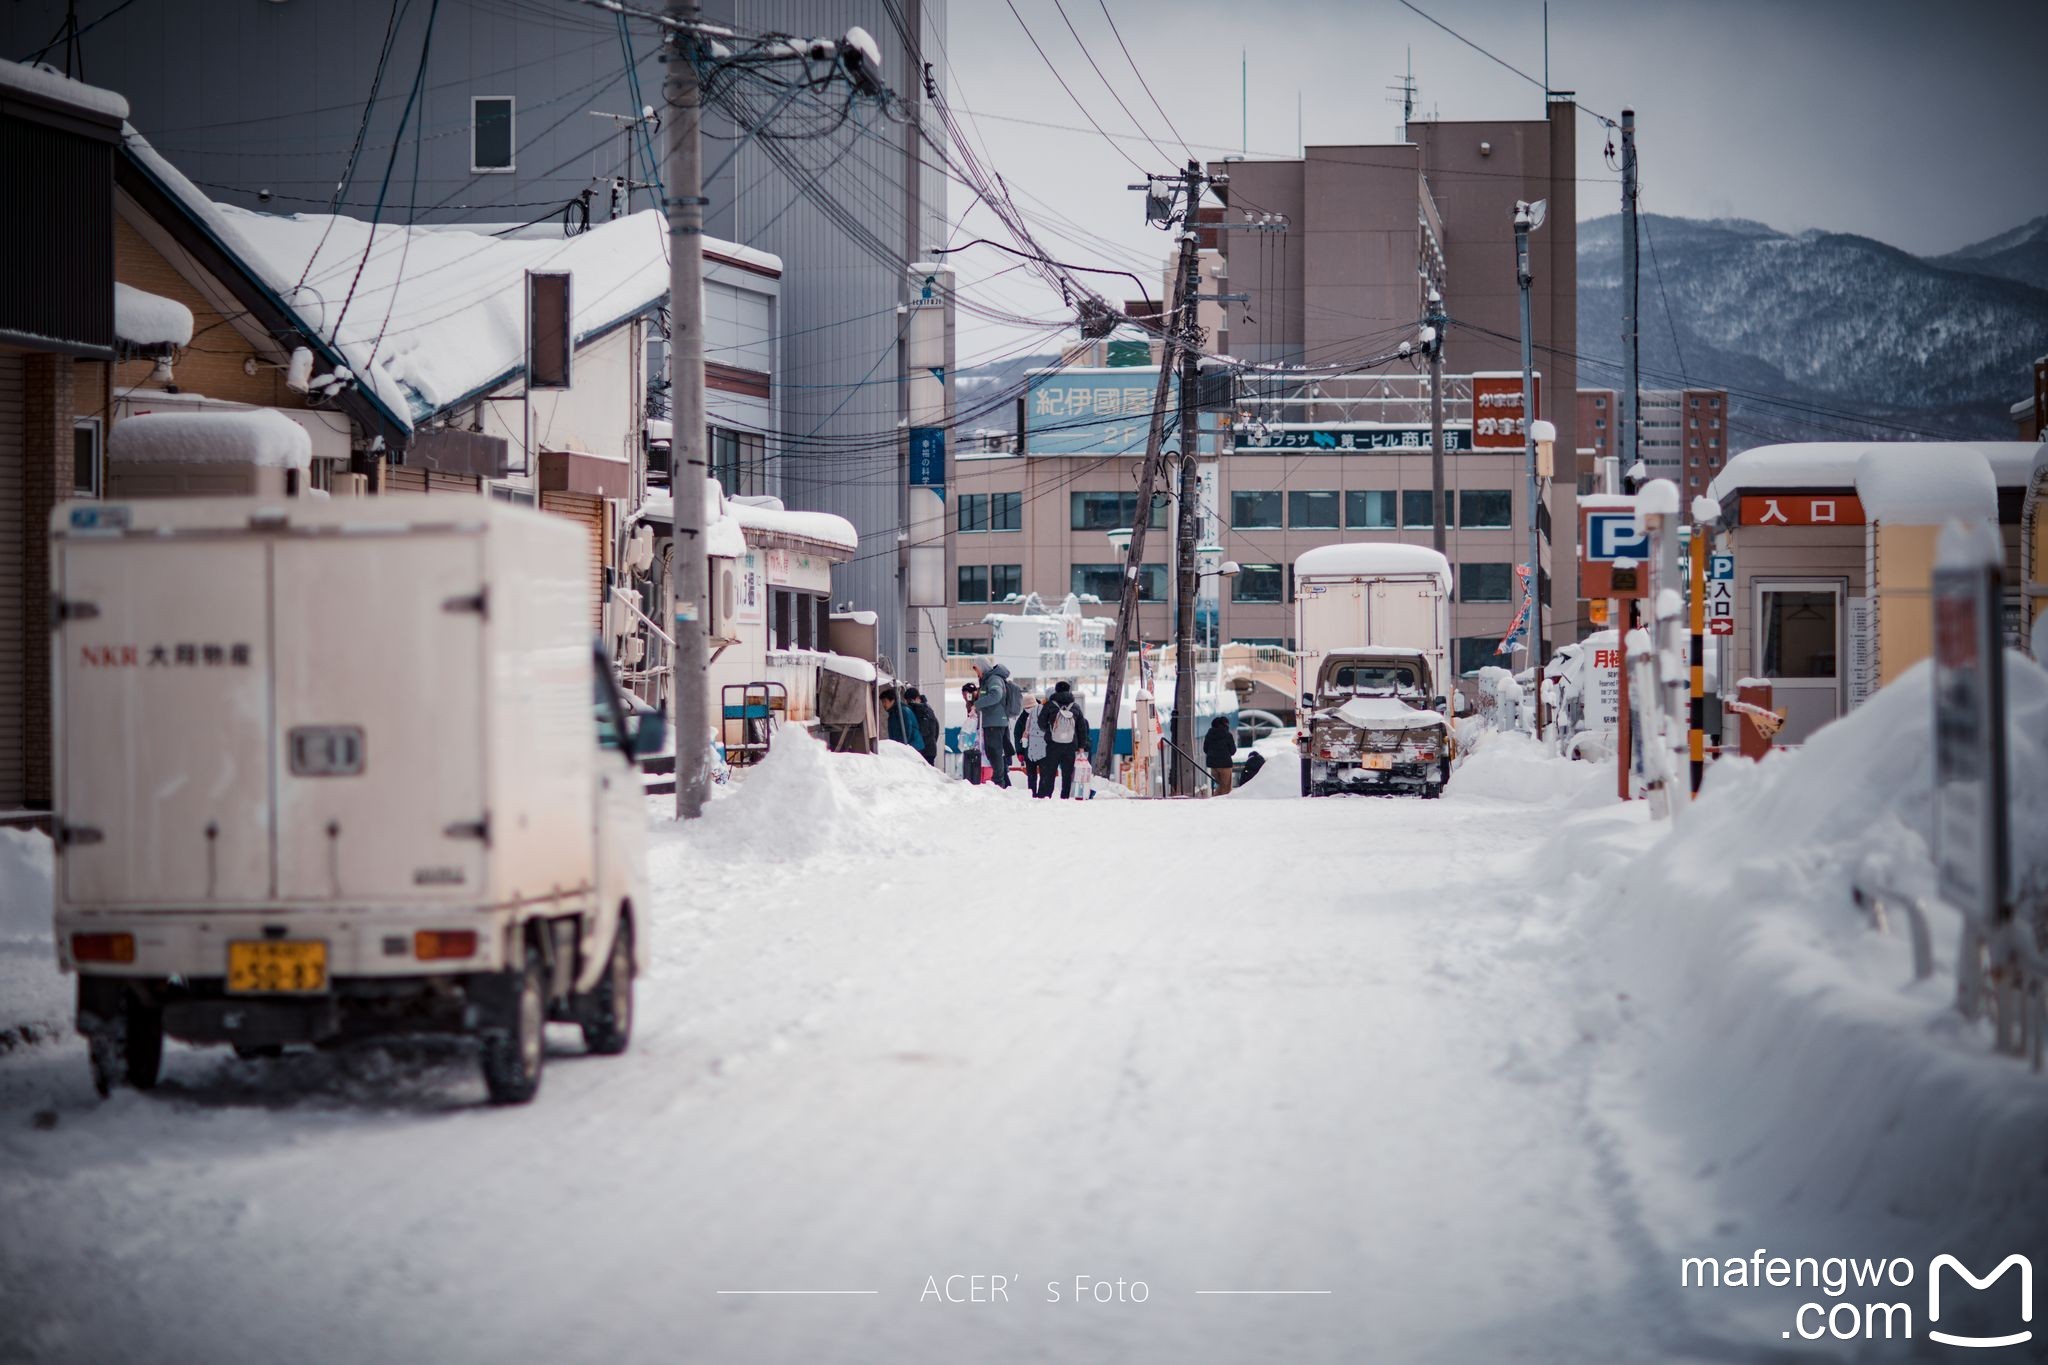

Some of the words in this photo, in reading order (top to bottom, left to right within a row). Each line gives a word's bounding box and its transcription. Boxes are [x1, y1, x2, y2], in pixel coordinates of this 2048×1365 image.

[1104, 426, 1138, 444] 2F
[1760, 500, 1838, 523] 入口
[1602, 519, 1647, 555] P
[1714, 558, 1731, 578] P
[1714, 582, 1731, 616] 入口
